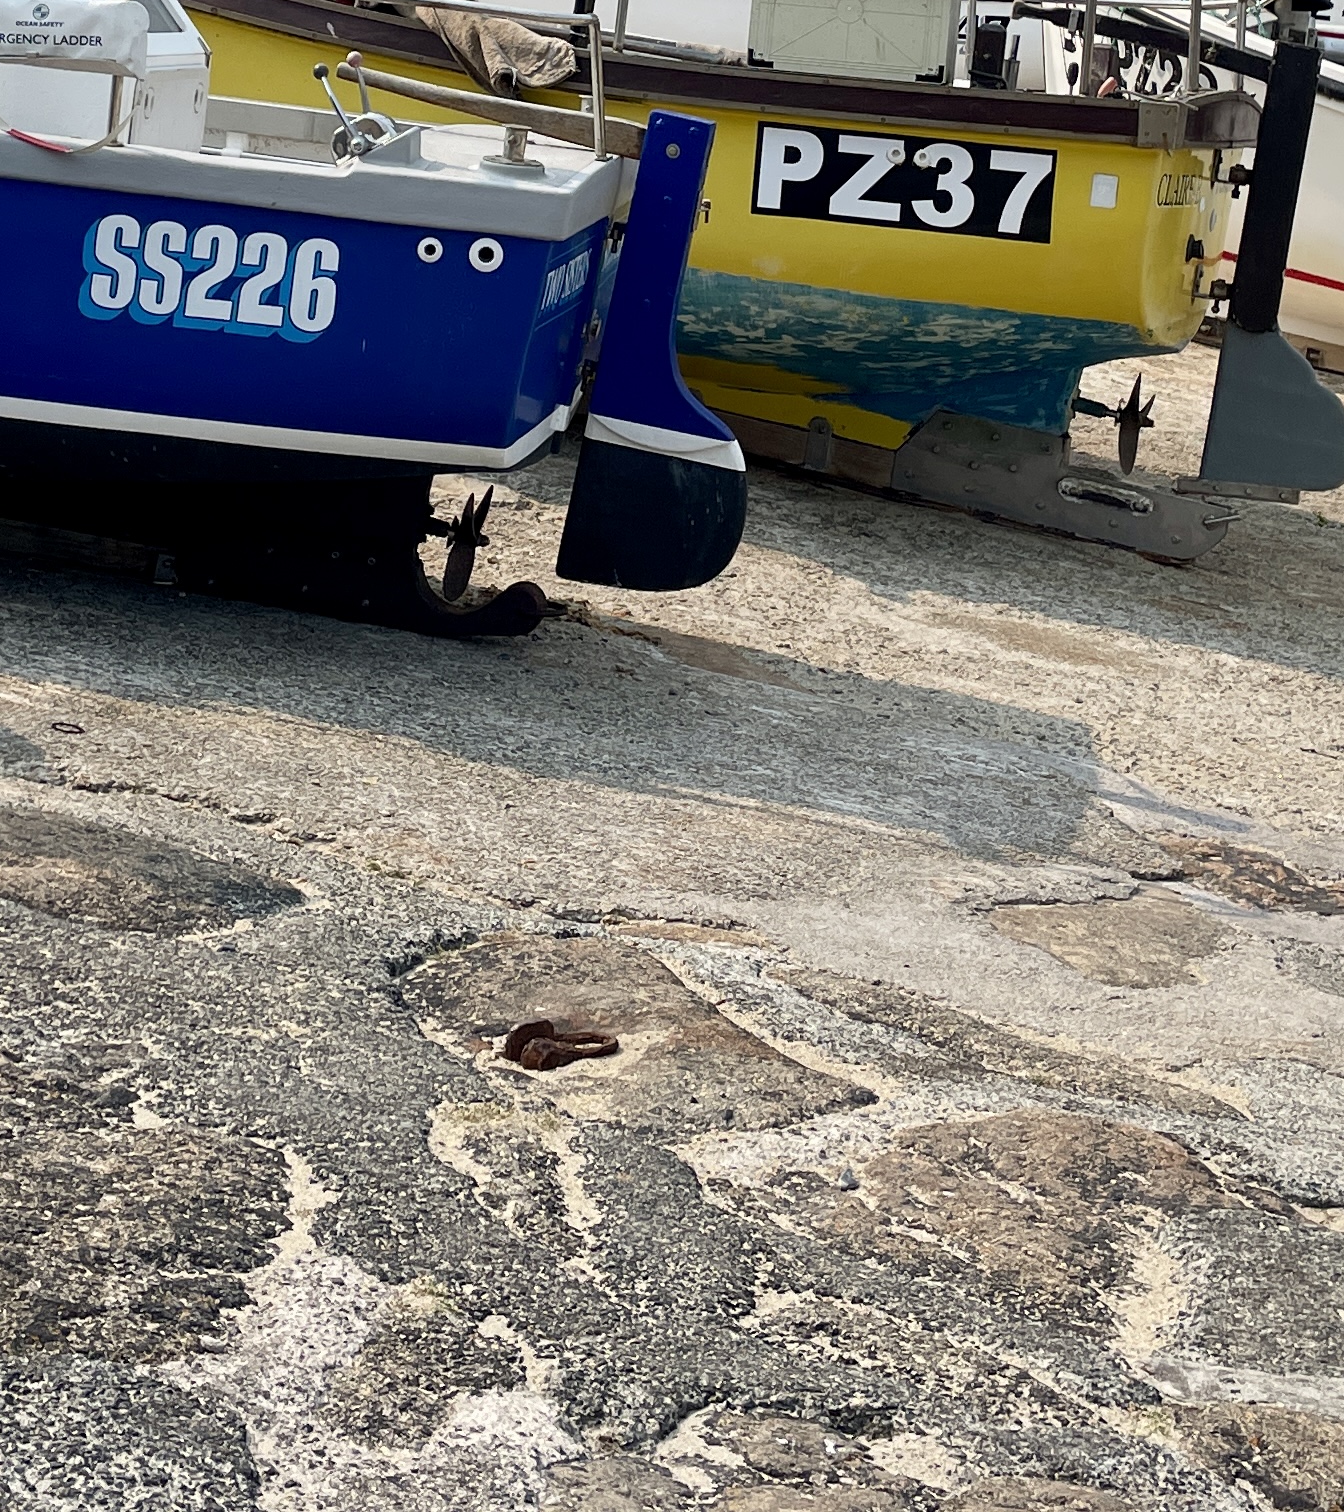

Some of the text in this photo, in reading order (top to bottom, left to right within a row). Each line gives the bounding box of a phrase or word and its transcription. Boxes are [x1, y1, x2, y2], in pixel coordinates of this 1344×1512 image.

[53, 34, 103, 47] LADDER
[756, 126, 1053, 235] PZ37
[80, 213, 341, 340] SS226
